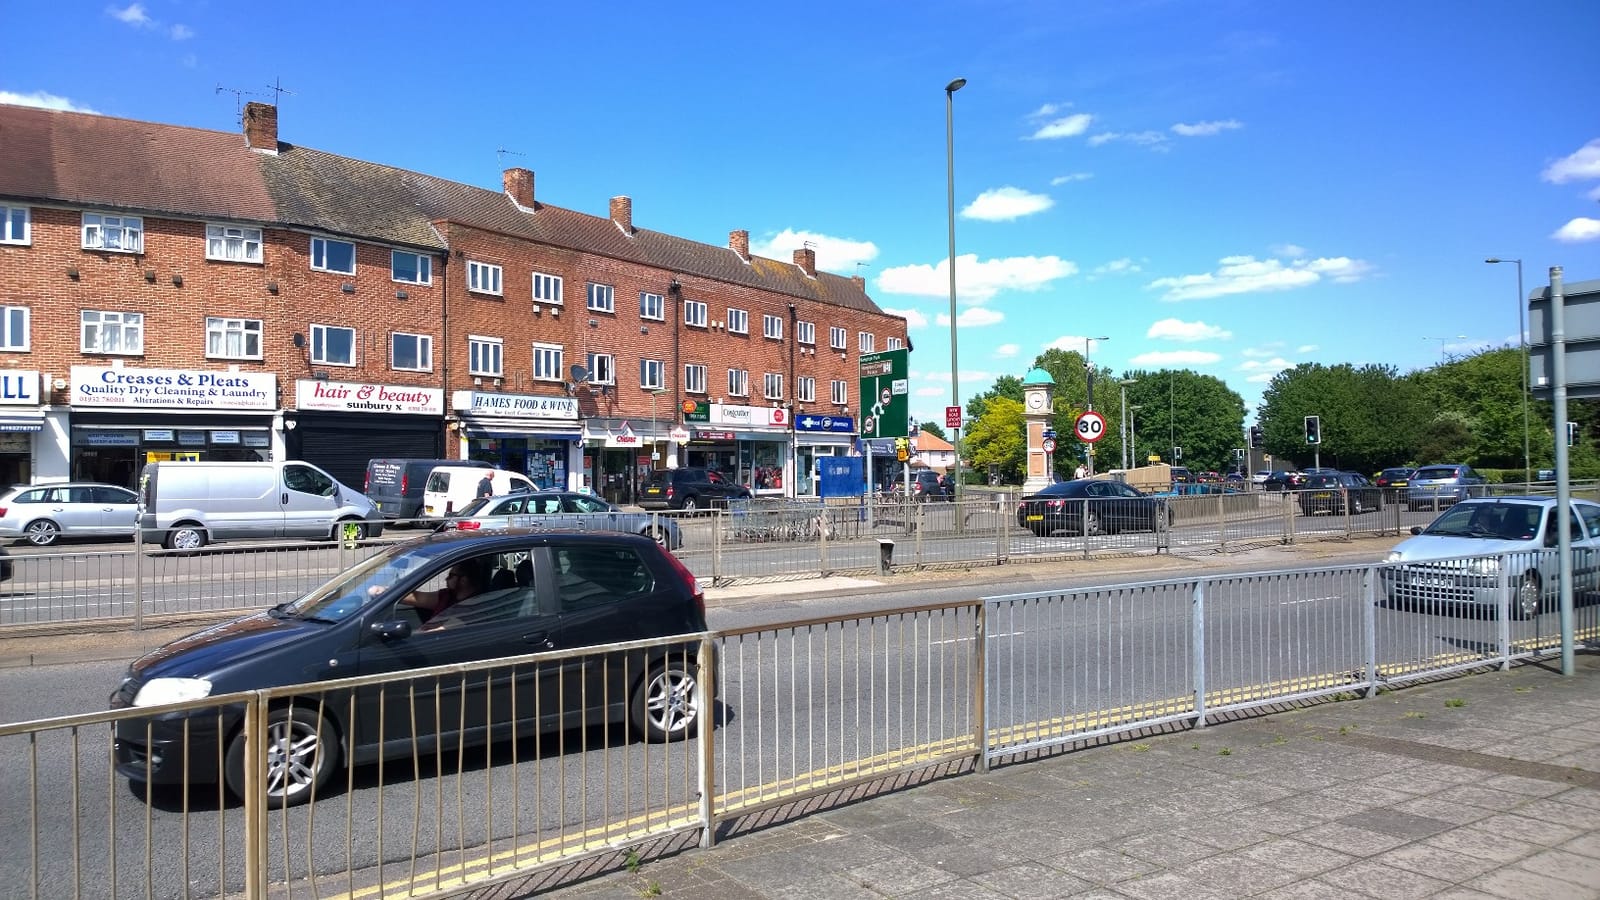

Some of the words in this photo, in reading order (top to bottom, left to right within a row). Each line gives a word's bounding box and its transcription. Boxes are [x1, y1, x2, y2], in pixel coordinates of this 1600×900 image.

[101, 371, 172, 385] Creases
[177, 373, 193, 386] &
[198, 374, 249, 387] Pleats
[0, 375, 30, 399] LL
[80, 384, 126, 396] Quality
[129, 386, 151, 397] Dry
[154, 387, 205, 398] Cleaning
[208, 388, 218, 396] &
[222, 389, 267, 400] Laundry
[314, 382, 351, 399] hair
[356, 385, 375, 400] &
[379, 386, 432, 406] beauty
[186, 398, 213, 406] Repairs
[347, 401, 392, 411] sunbury
[475, 397, 511, 409] HAMES
[514, 399, 538, 410] FOOD
[540, 400, 547, 410] &
[549, 401, 573, 412] WINE
[1079, 420, 1102, 433] 30
